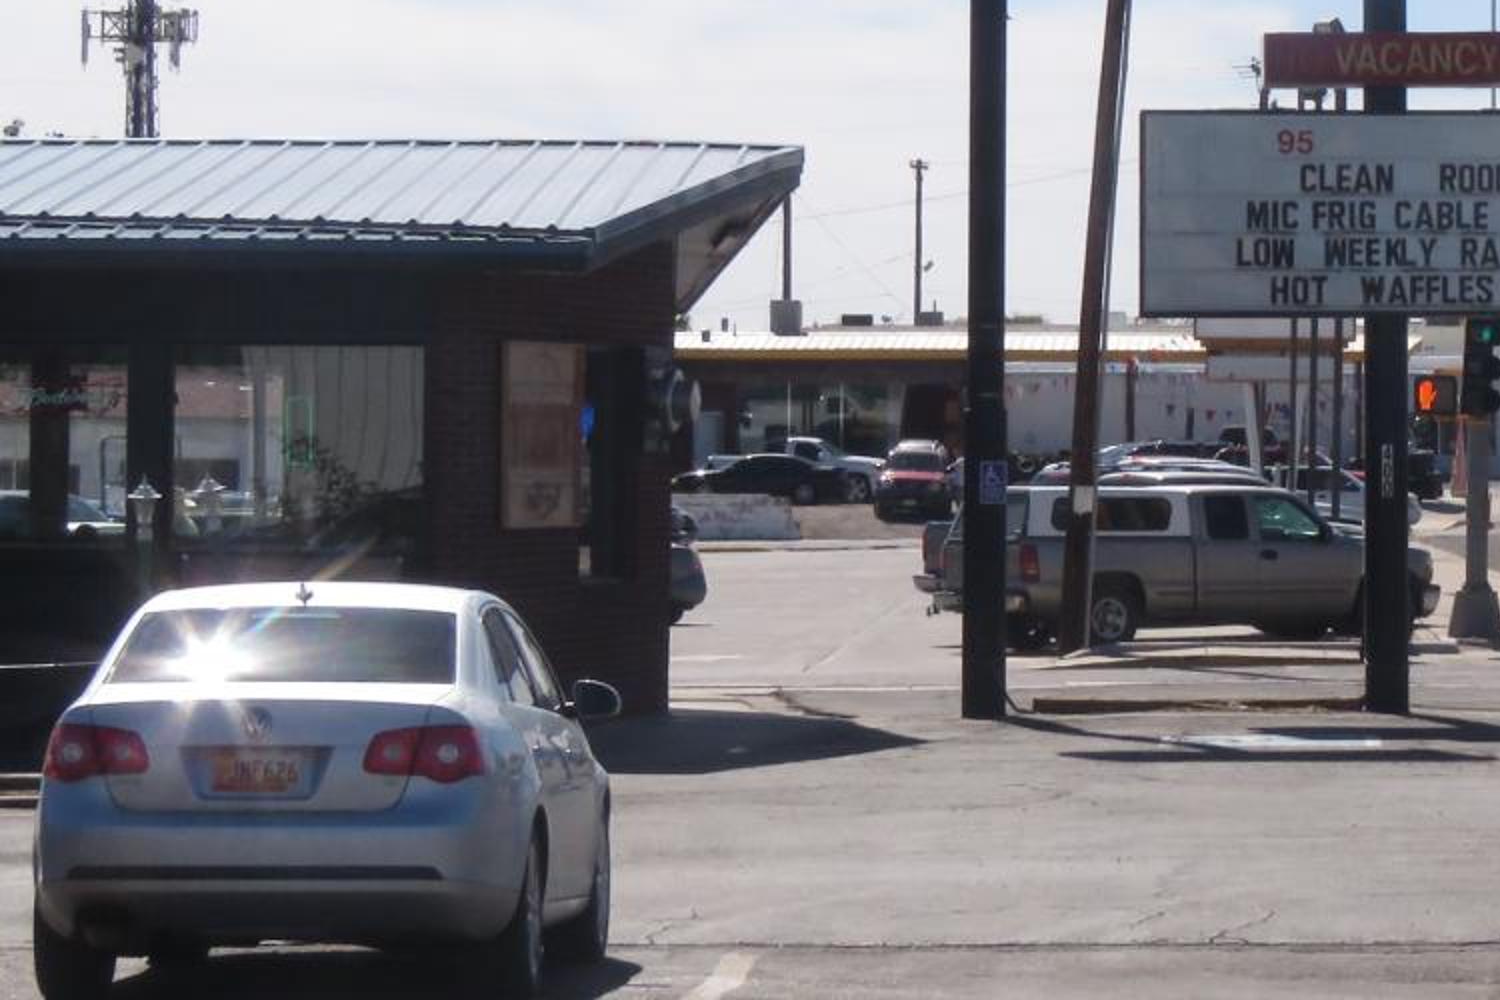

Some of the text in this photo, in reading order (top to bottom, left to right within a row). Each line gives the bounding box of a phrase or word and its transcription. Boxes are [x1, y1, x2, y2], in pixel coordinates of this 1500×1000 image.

[1335, 43, 1499, 75] VACANCY
[1277, 130, 1314, 154] 95
[1300, 164, 1394, 193] CLEAN
[1246, 201, 1298, 230] MIC
[1312, 201, 1377, 230] FRIG
[1394, 201, 1489, 230] CABLE
[1236, 238, 1295, 268] LOW
[1324, 238, 1438, 267] WEEKLY
[1270, 275, 1495, 305] HOT WAFFLES
